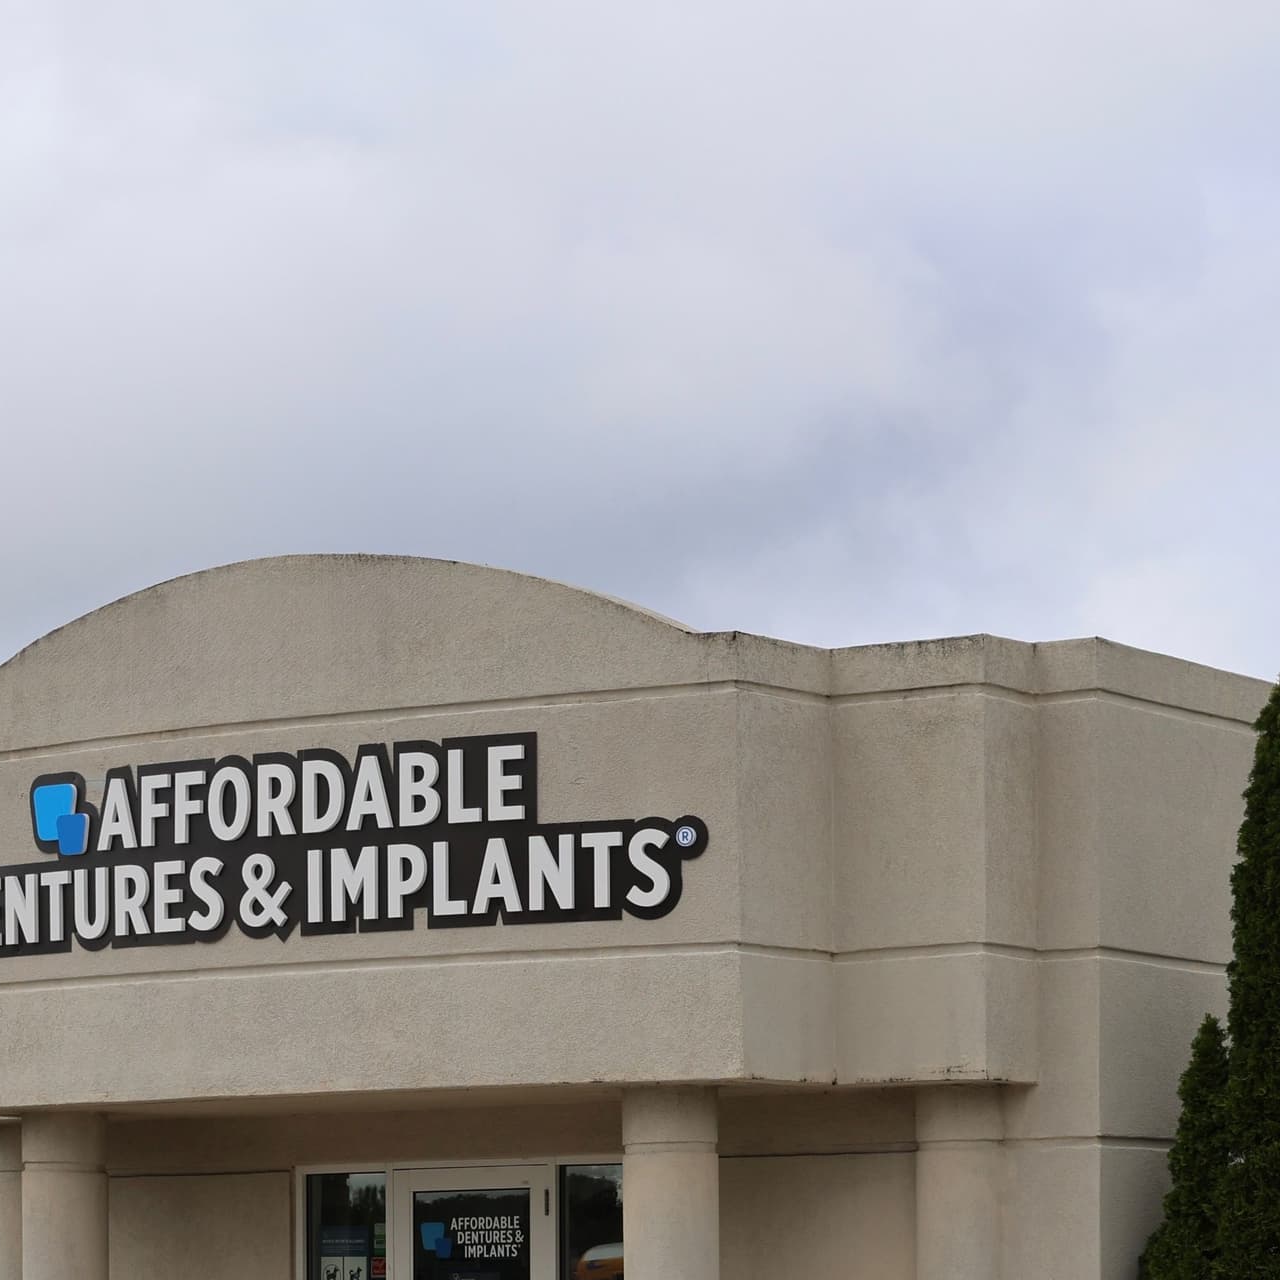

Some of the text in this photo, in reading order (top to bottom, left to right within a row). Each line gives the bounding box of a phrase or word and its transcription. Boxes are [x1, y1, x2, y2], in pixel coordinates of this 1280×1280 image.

[97, 745, 526, 851] AFFORDABLE
[239, 852, 293, 929] &
[450, 1216, 520, 1230] AFFORDABLE
[457, 1230, 525, 1244] DENTURES &
